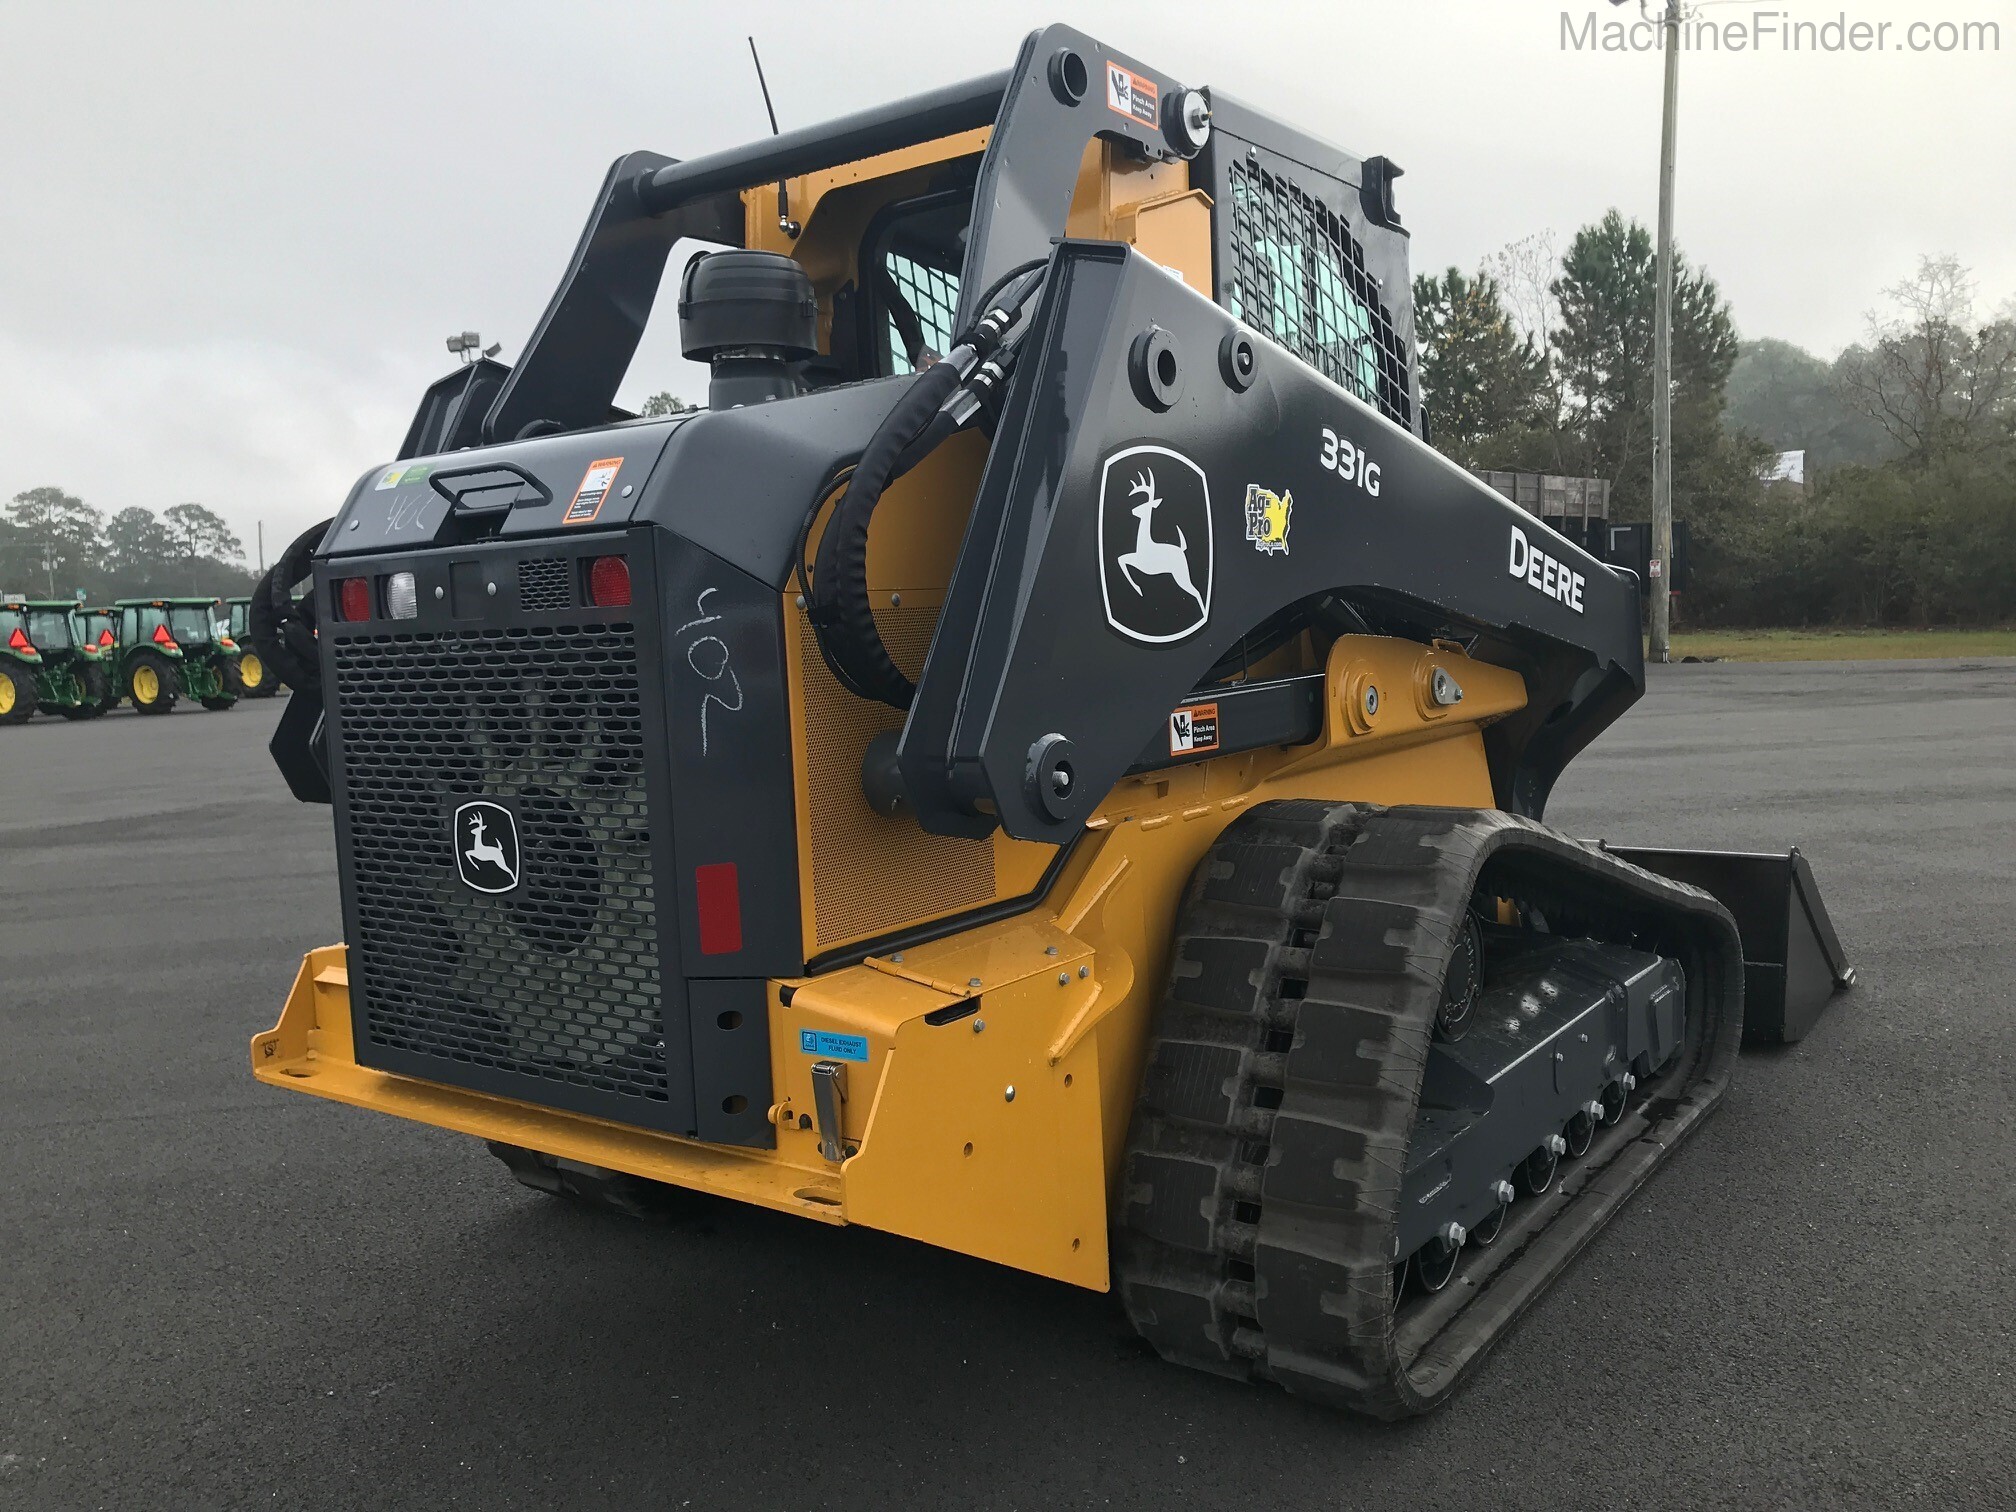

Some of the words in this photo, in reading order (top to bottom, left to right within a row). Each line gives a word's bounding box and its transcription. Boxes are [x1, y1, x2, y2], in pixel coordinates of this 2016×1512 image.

[1132, 94, 1144, 105] Pinch
[1320, 428, 1381, 497] 331G
[1248, 513, 1271, 536] Pro
[1509, 525, 1586, 614] DEERE
[1197, 708, 1216, 716] WARNING
[1193, 725, 1205, 734] Pinch
[1194, 735, 1203, 743] Keep
[1203, 734, 1213, 742] Away
[839, 1038, 863, 1047] EXHAUST
[828, 1043, 843, 1052] FLUID
[843, 1046, 857, 1054] ONLY
